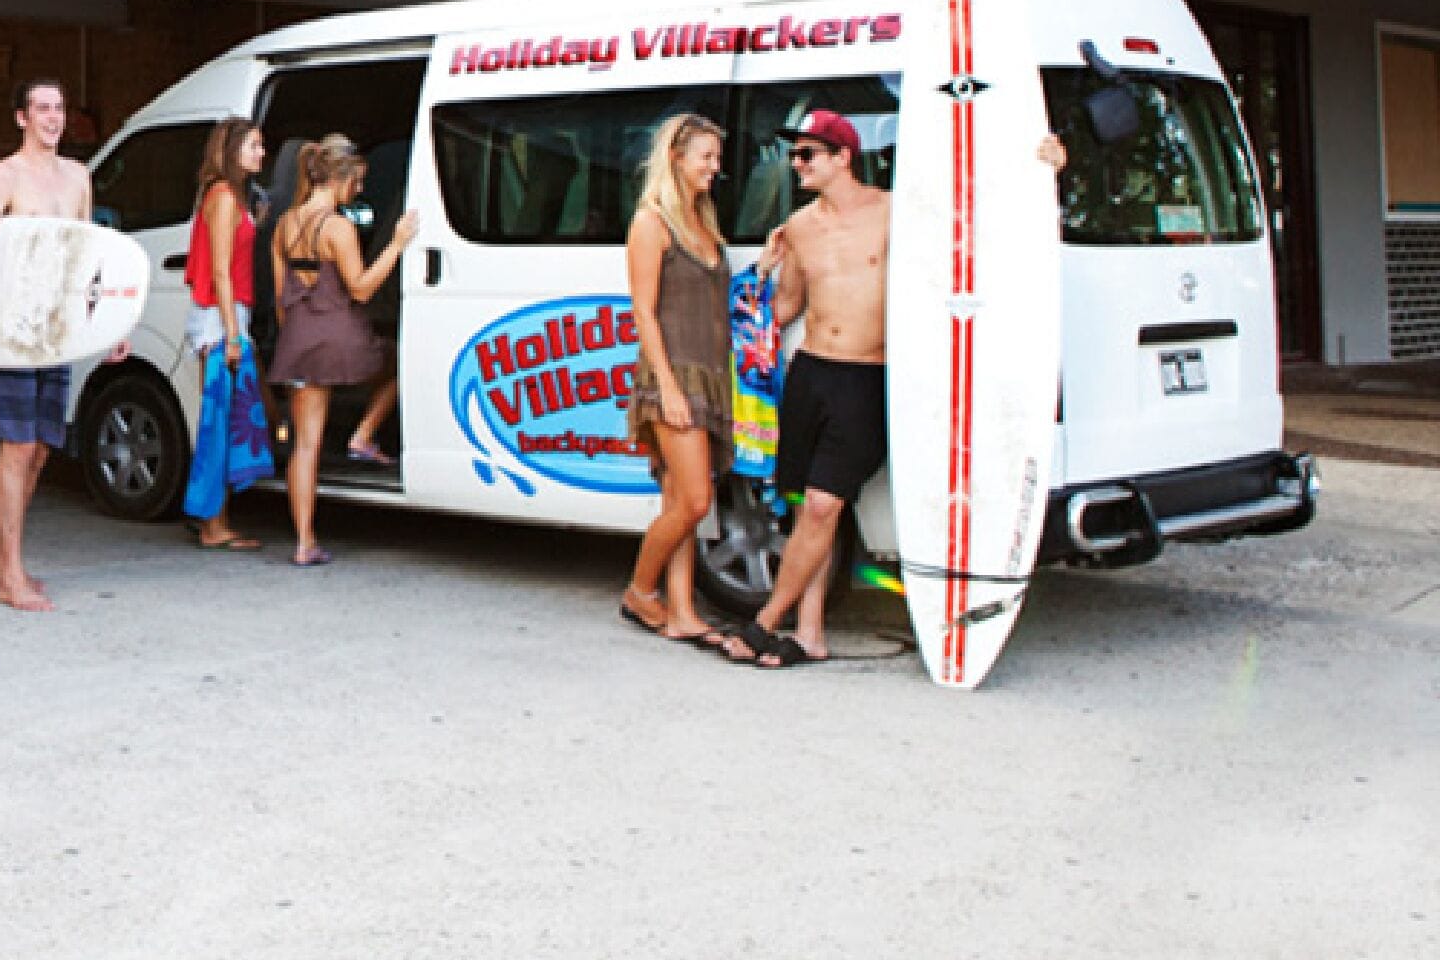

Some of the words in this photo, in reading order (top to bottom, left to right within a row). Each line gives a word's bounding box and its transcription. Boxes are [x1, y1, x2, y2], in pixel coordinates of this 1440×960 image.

[449, 35, 620, 75] Holiday
[476, 305, 640, 383] Holida
[487, 362, 638, 427] Villag
